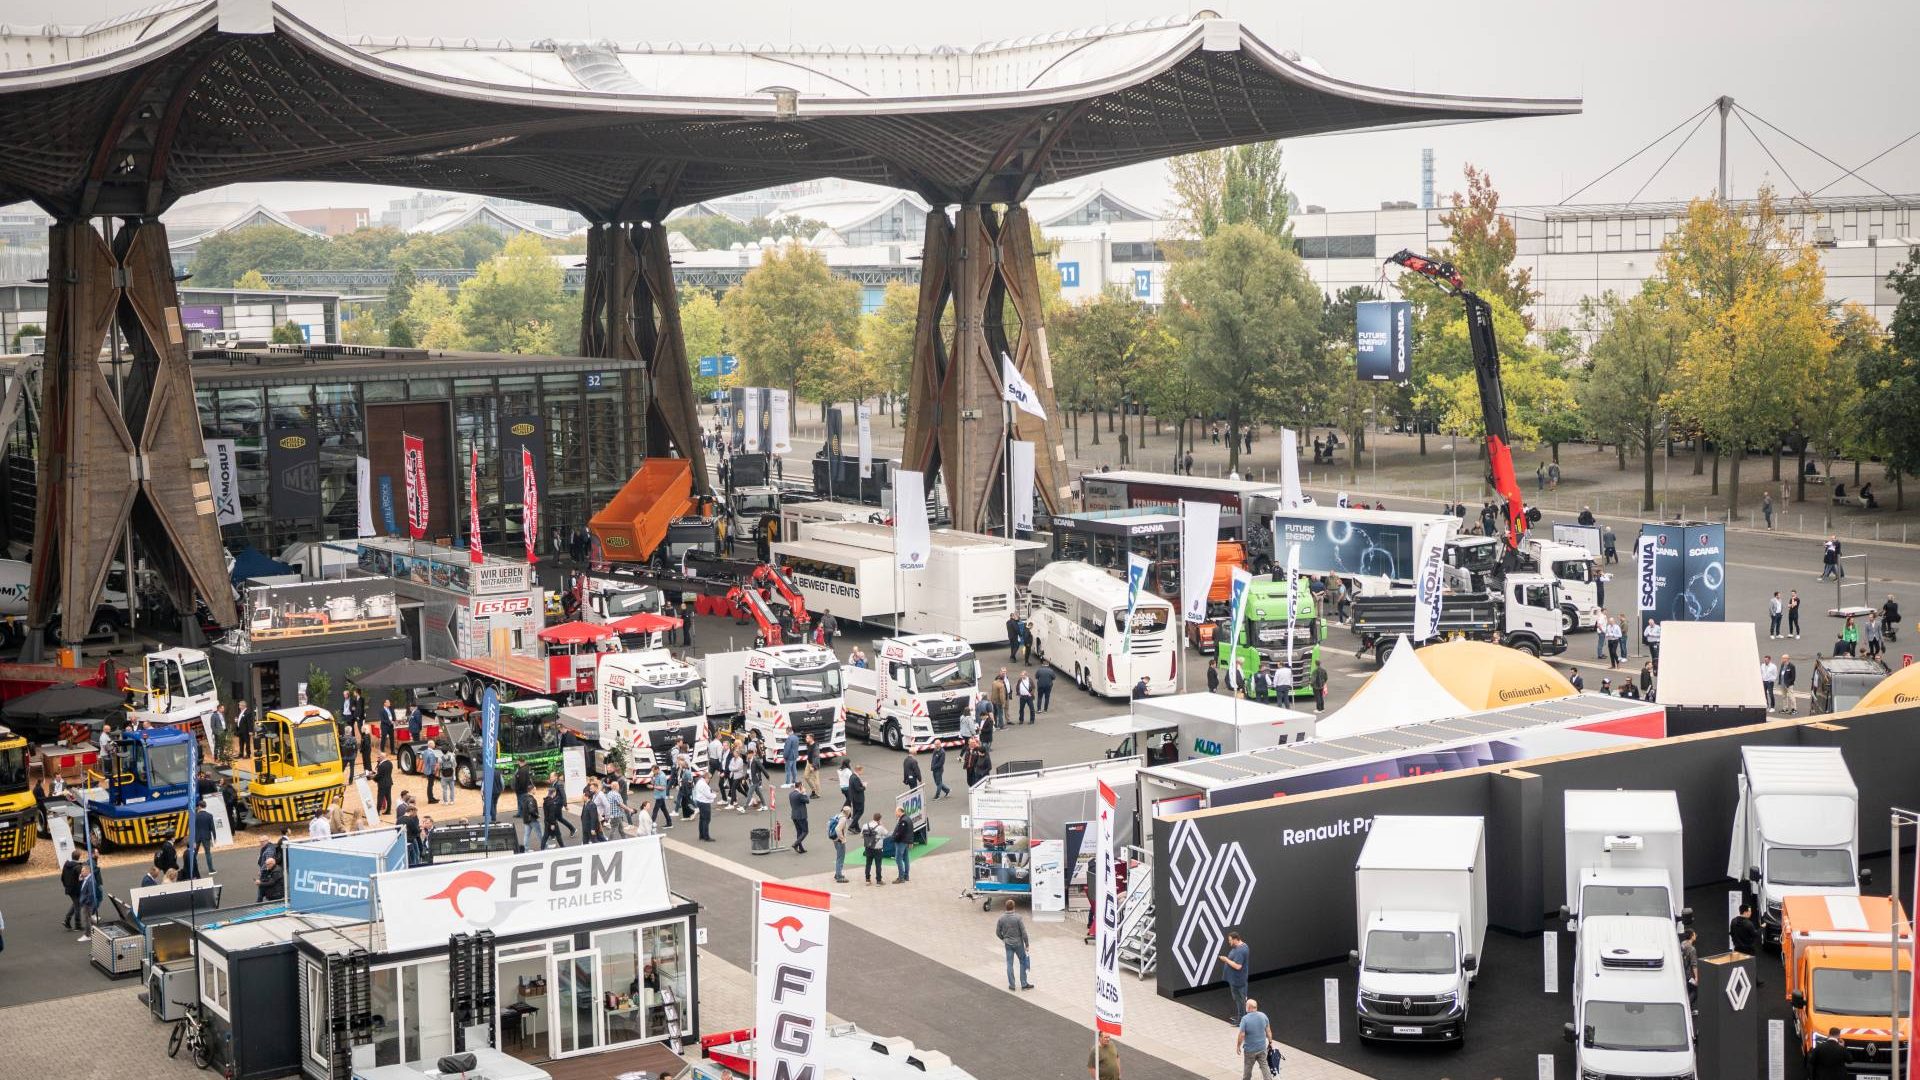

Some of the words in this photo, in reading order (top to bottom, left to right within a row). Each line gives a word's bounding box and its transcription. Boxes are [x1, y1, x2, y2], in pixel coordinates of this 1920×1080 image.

[1061, 266, 1075, 282] 11
[1136, 275, 1149, 291] 12
[1398, 308, 1406, 373] SCANIA
[588, 375, 601, 387] 32
[1053, 518, 1075, 528] SCANIA
[1131, 524, 1164, 534] SCANIA
[1285, 524, 1315, 533] FUTURE
[1285, 534, 1316, 542] ENERGY
[1655, 547, 1679, 557] CANIA
[1688, 547, 1720, 557] SCANIA
[480, 569, 497, 579] WIR
[499, 567, 523, 577] LEBEN
[1641, 542, 1655, 607] SCANIA
[799, 577, 829, 592] BEWEGT
[830, 582, 860, 599] EVENTS
[1499, 685, 1545, 702] Continental
[1194, 737, 1222, 756] KUDA
[1283, 819, 1351, 846] Renault
[1354, 817, 1374, 834] Pr
[509, 849, 624, 899] FGM
[547, 887, 623, 912] TRAILERS
